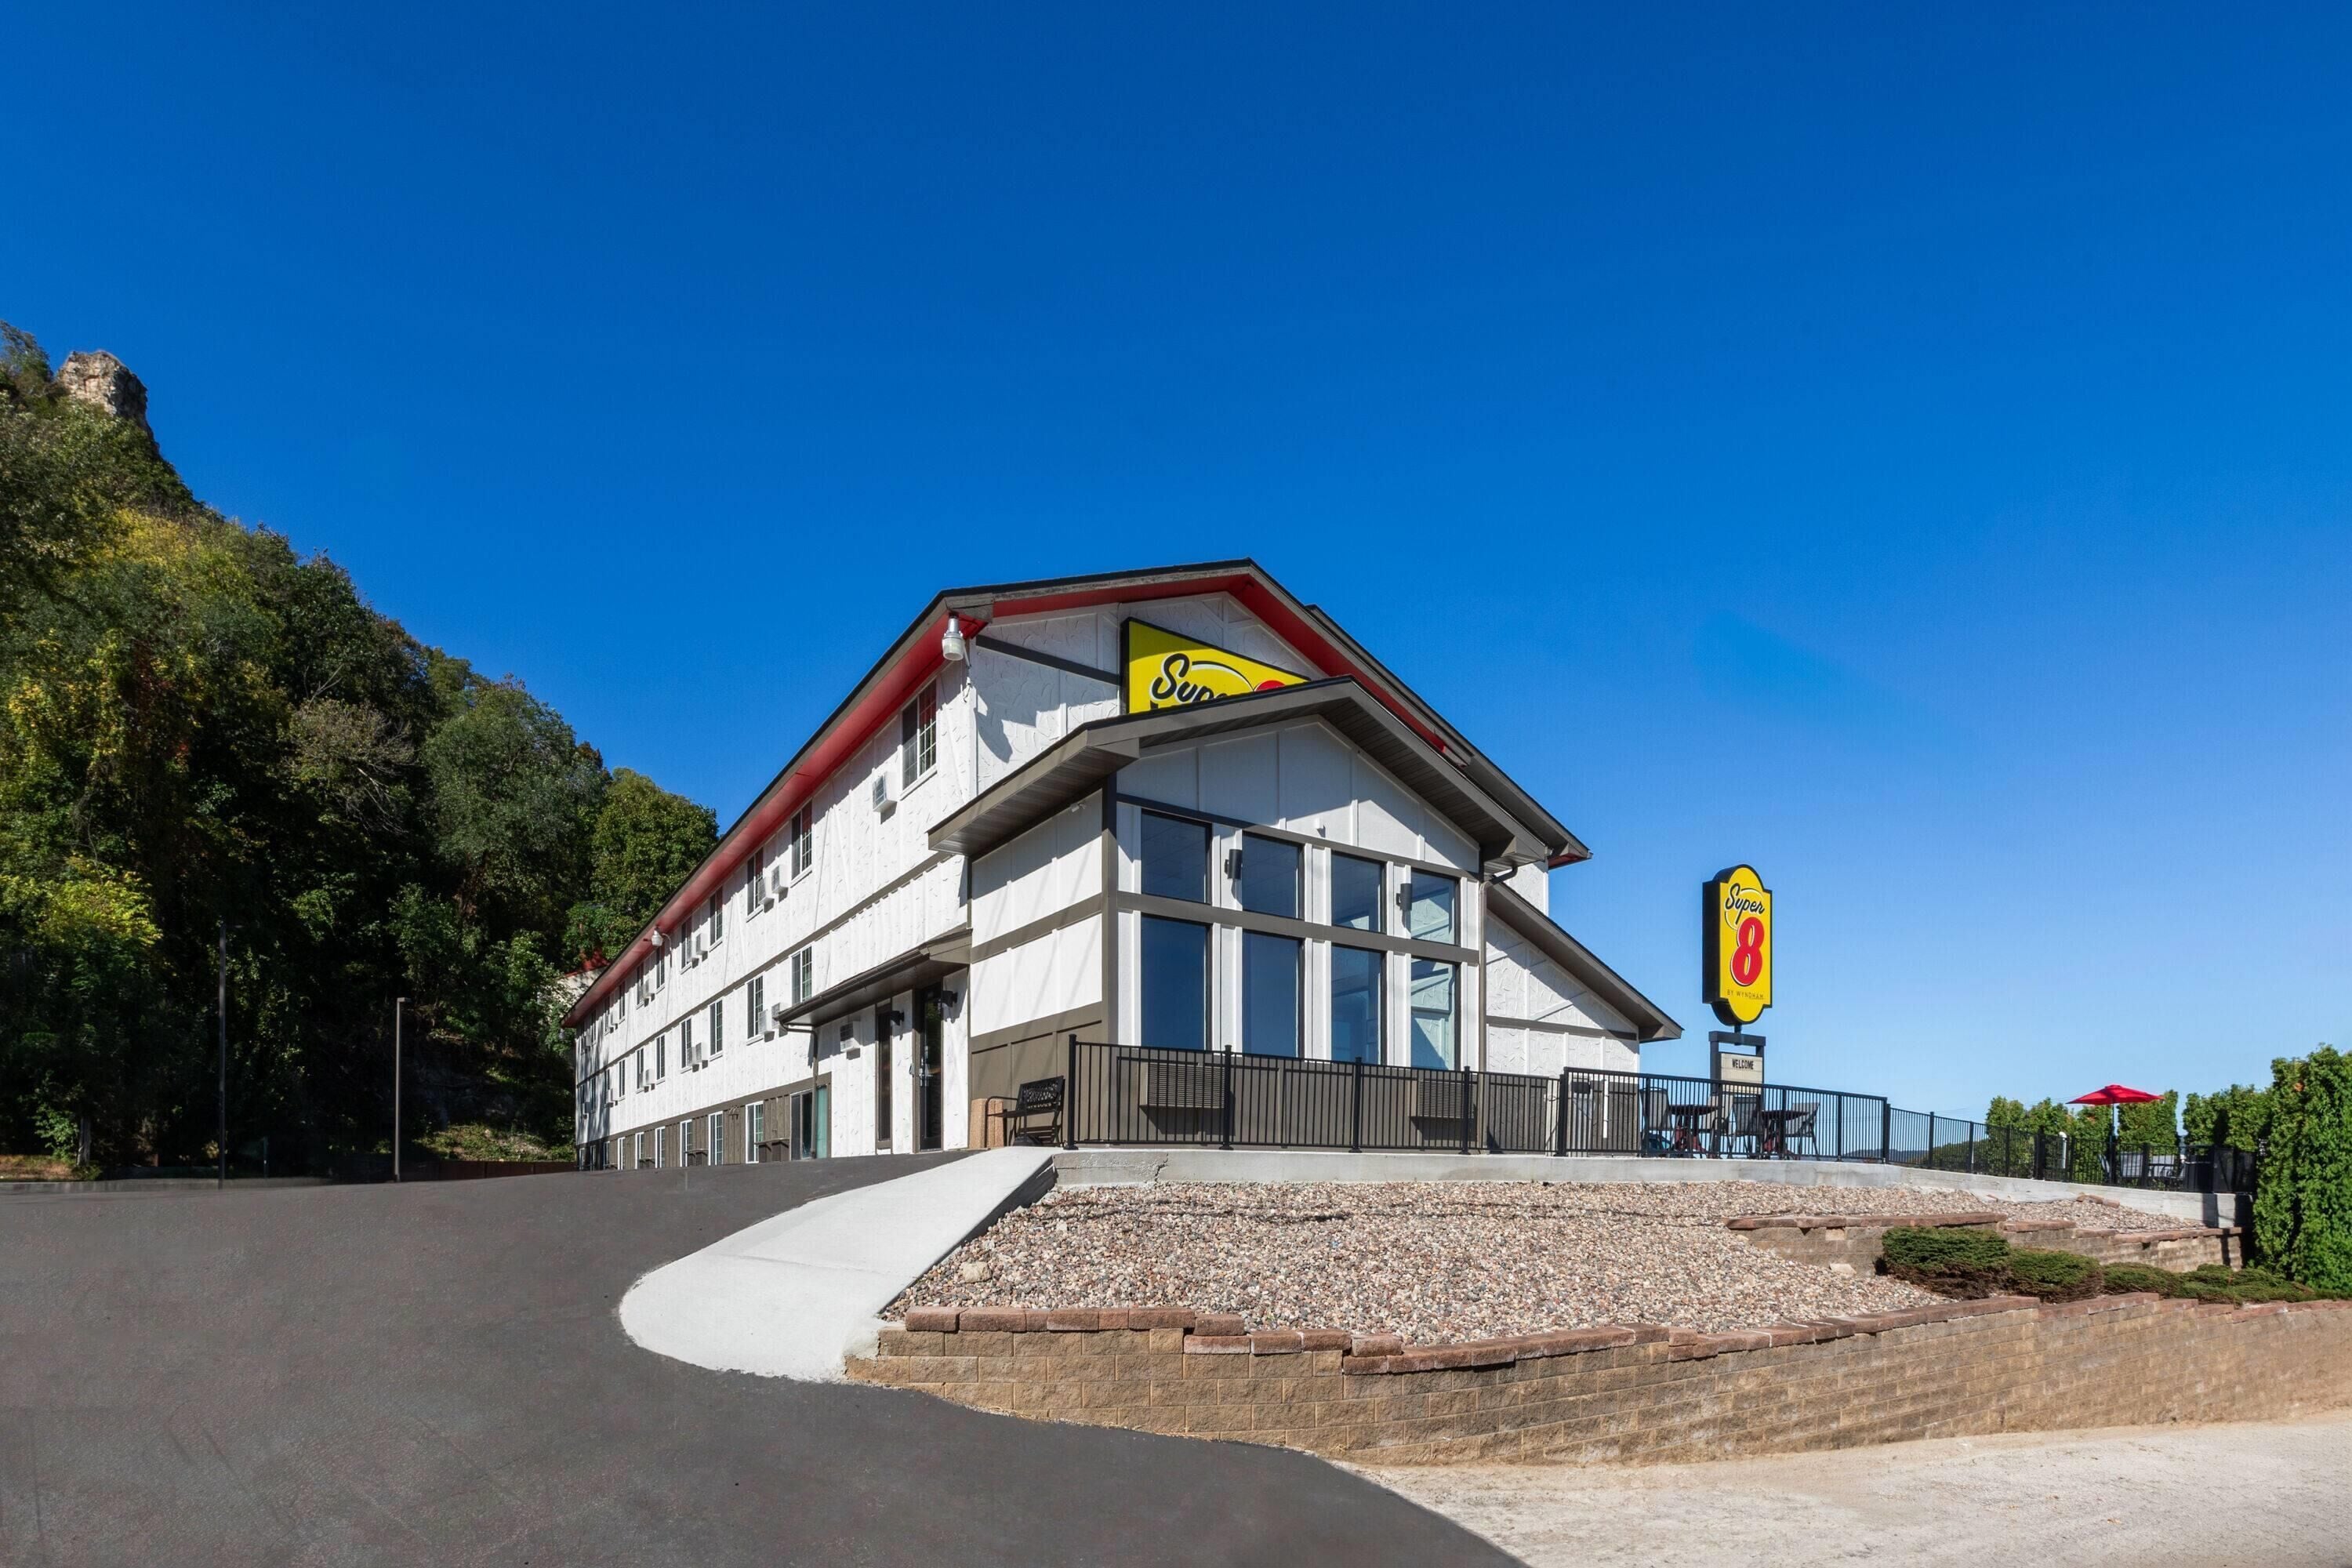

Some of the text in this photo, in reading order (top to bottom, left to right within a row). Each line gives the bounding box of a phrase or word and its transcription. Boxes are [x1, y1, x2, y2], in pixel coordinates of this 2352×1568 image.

[1725, 883, 1766, 925] Super
[1730, 916, 1765, 986] 8
[1736, 990, 1764, 999] WYNDHAM
[1731, 1058, 1755, 1070] WELCOME
